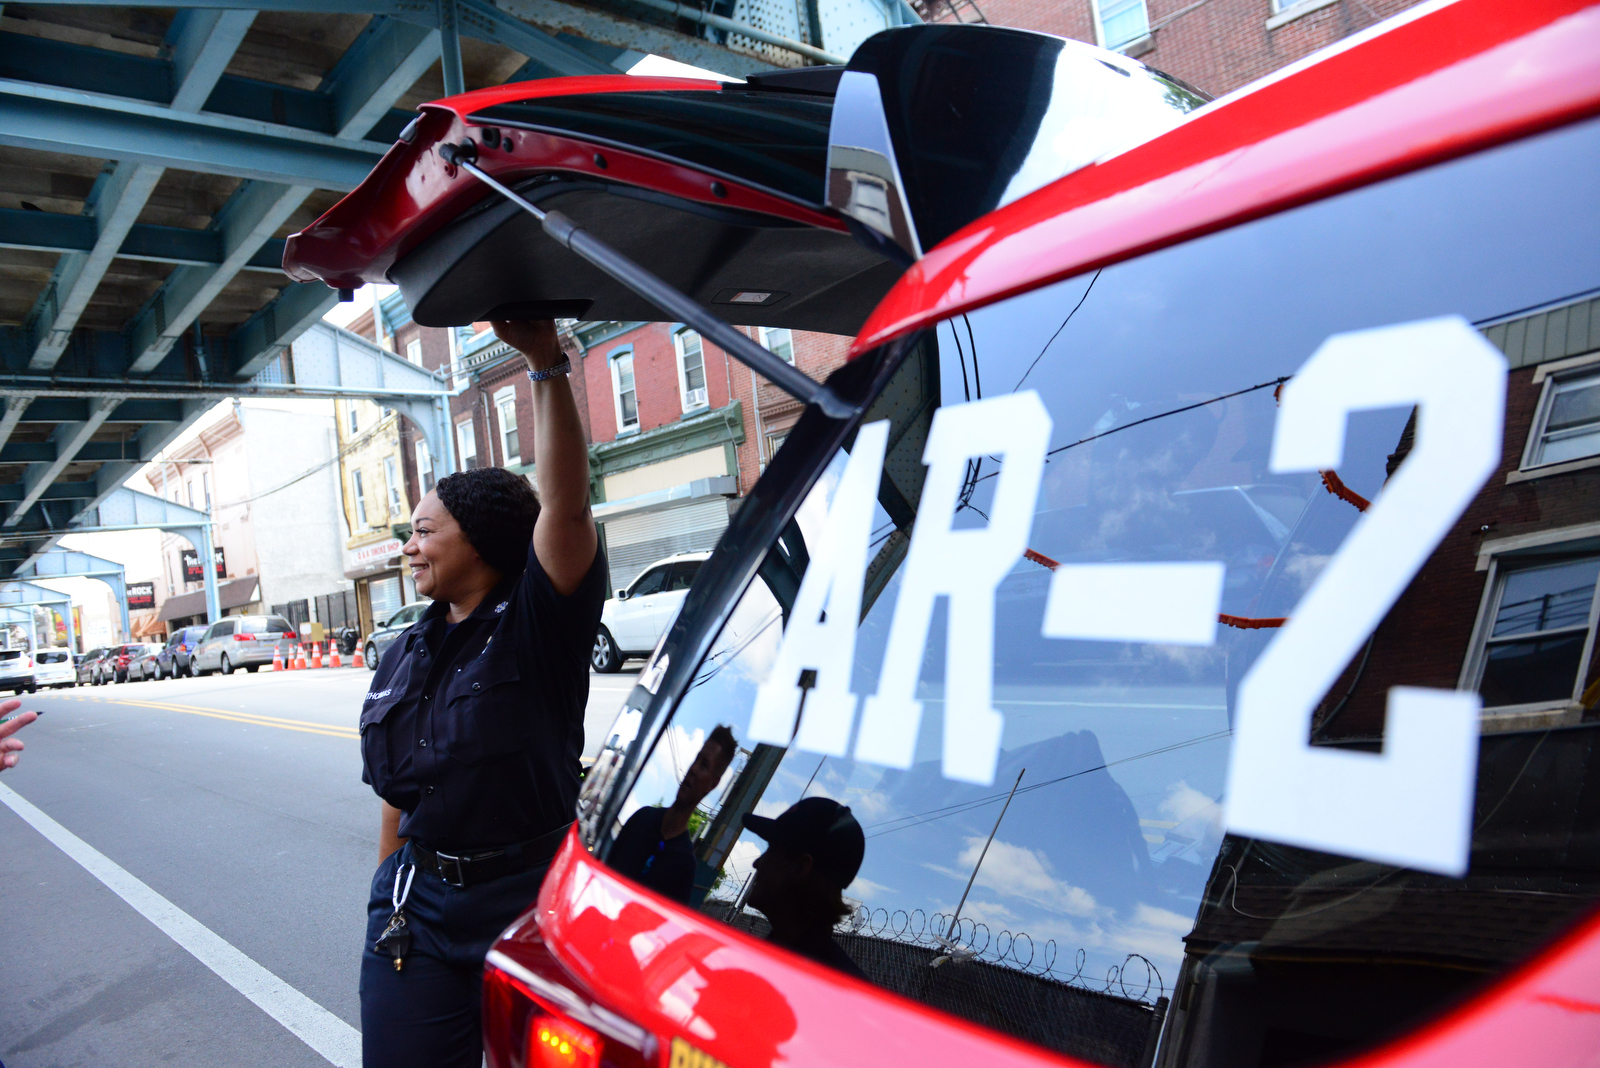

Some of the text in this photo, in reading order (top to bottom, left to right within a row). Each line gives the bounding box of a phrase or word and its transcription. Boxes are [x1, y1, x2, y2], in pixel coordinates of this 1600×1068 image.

[371, 545, 386, 556] SMOKE
[387, 541, 400, 552] SHOP
[131, 586, 153, 595] ROCK
[748, 316, 1508, 876] AR-2
